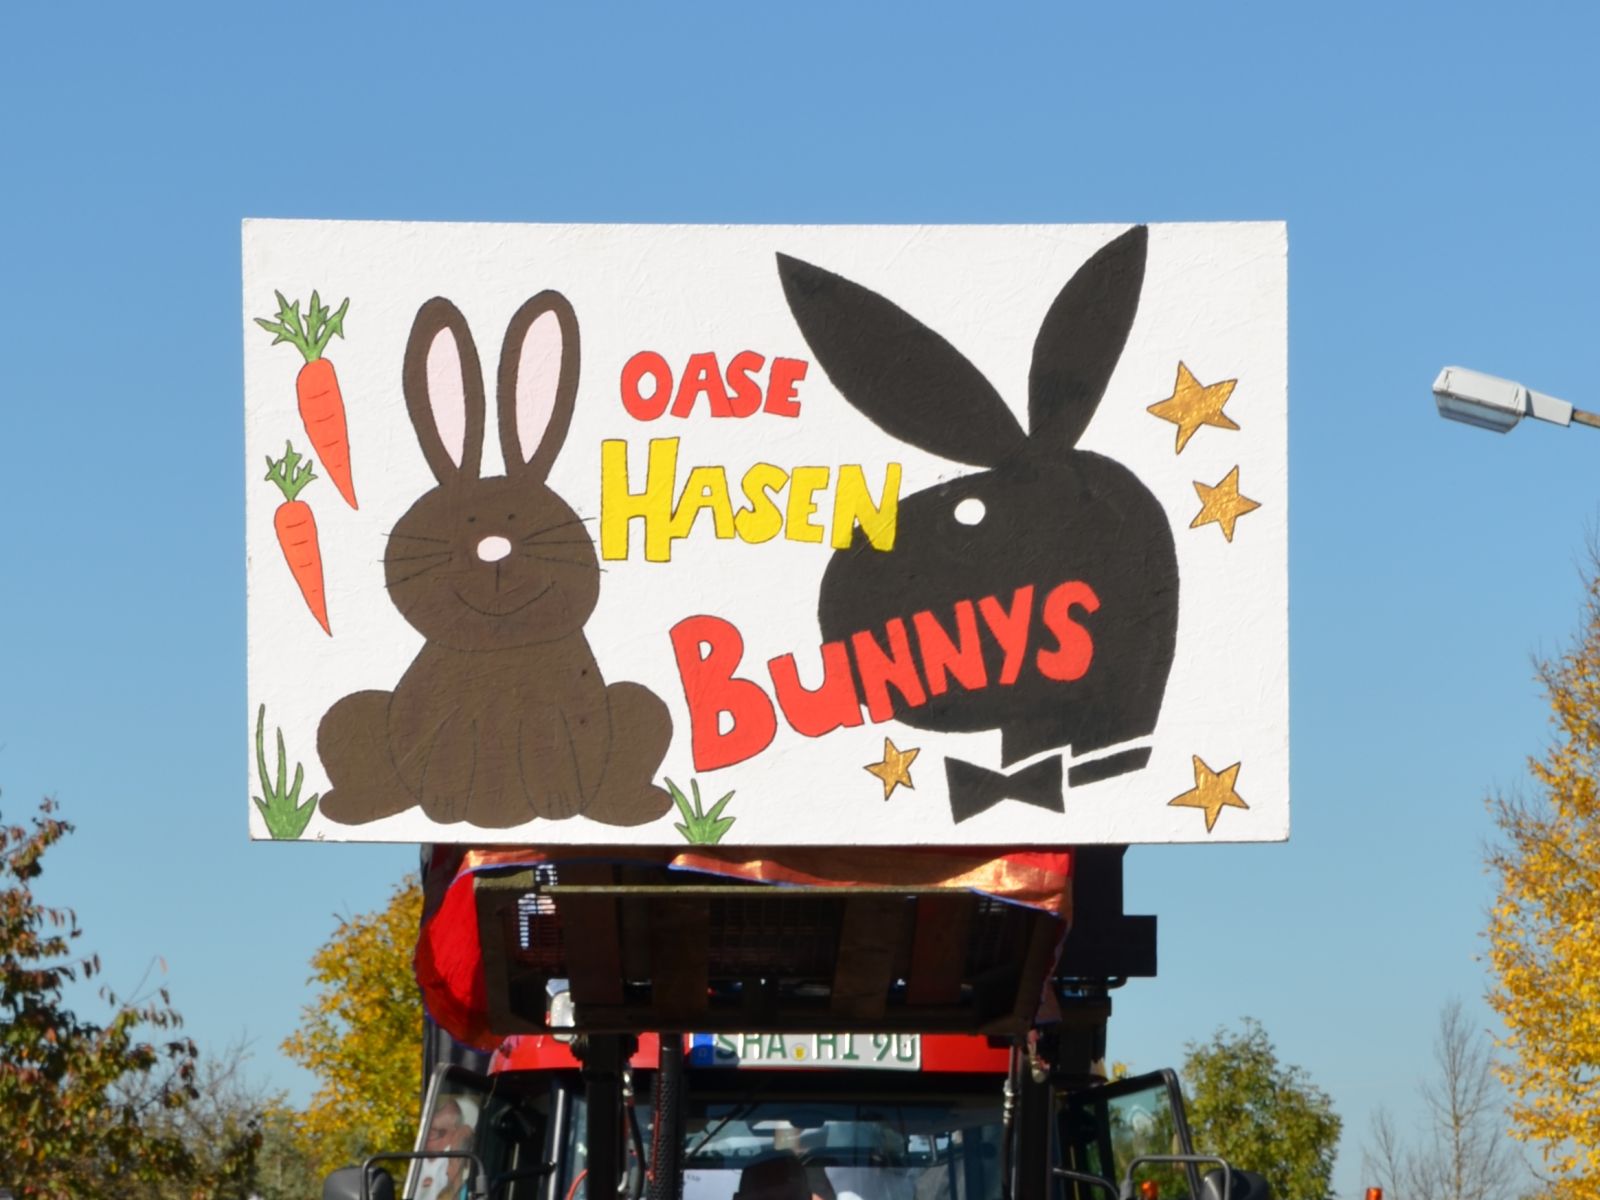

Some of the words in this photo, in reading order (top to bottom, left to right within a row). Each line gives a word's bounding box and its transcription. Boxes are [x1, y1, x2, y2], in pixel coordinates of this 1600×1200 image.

[620, 350, 808, 421] OASE
[600, 436, 902, 563] HASEN
[716, 1033, 788, 1060] SHA
[817, 1033, 860, 1060] HI
